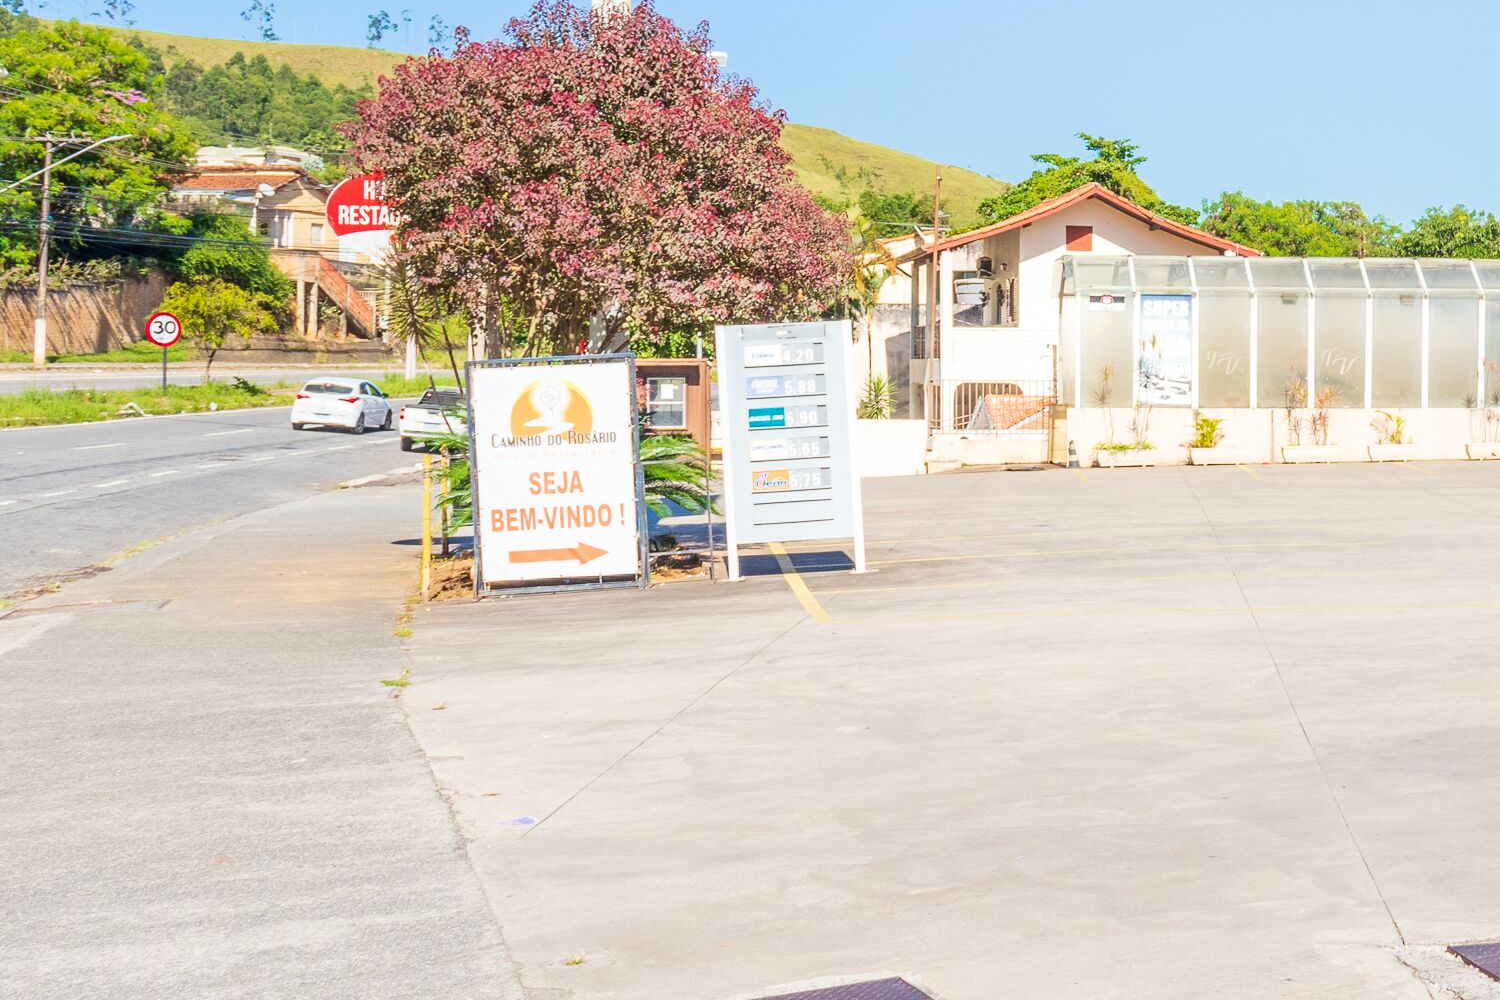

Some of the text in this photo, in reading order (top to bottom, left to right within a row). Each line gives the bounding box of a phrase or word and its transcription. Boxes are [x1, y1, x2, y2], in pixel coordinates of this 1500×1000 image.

[1143, 300, 1190, 317] SUPER
[153, 320, 177, 335] 30
[782, 347, 814, 363] 4.20
[784, 379, 816, 395] 5.88
[786, 410, 818, 426] 5.90
[491, 433, 542, 448] CAMINHO
[788, 442, 820, 457] 5.65
[529, 470, 584, 495] SEJA
[790, 472, 822, 488] 5.75
[491, 503, 626, 533] BEM-VINDO !
